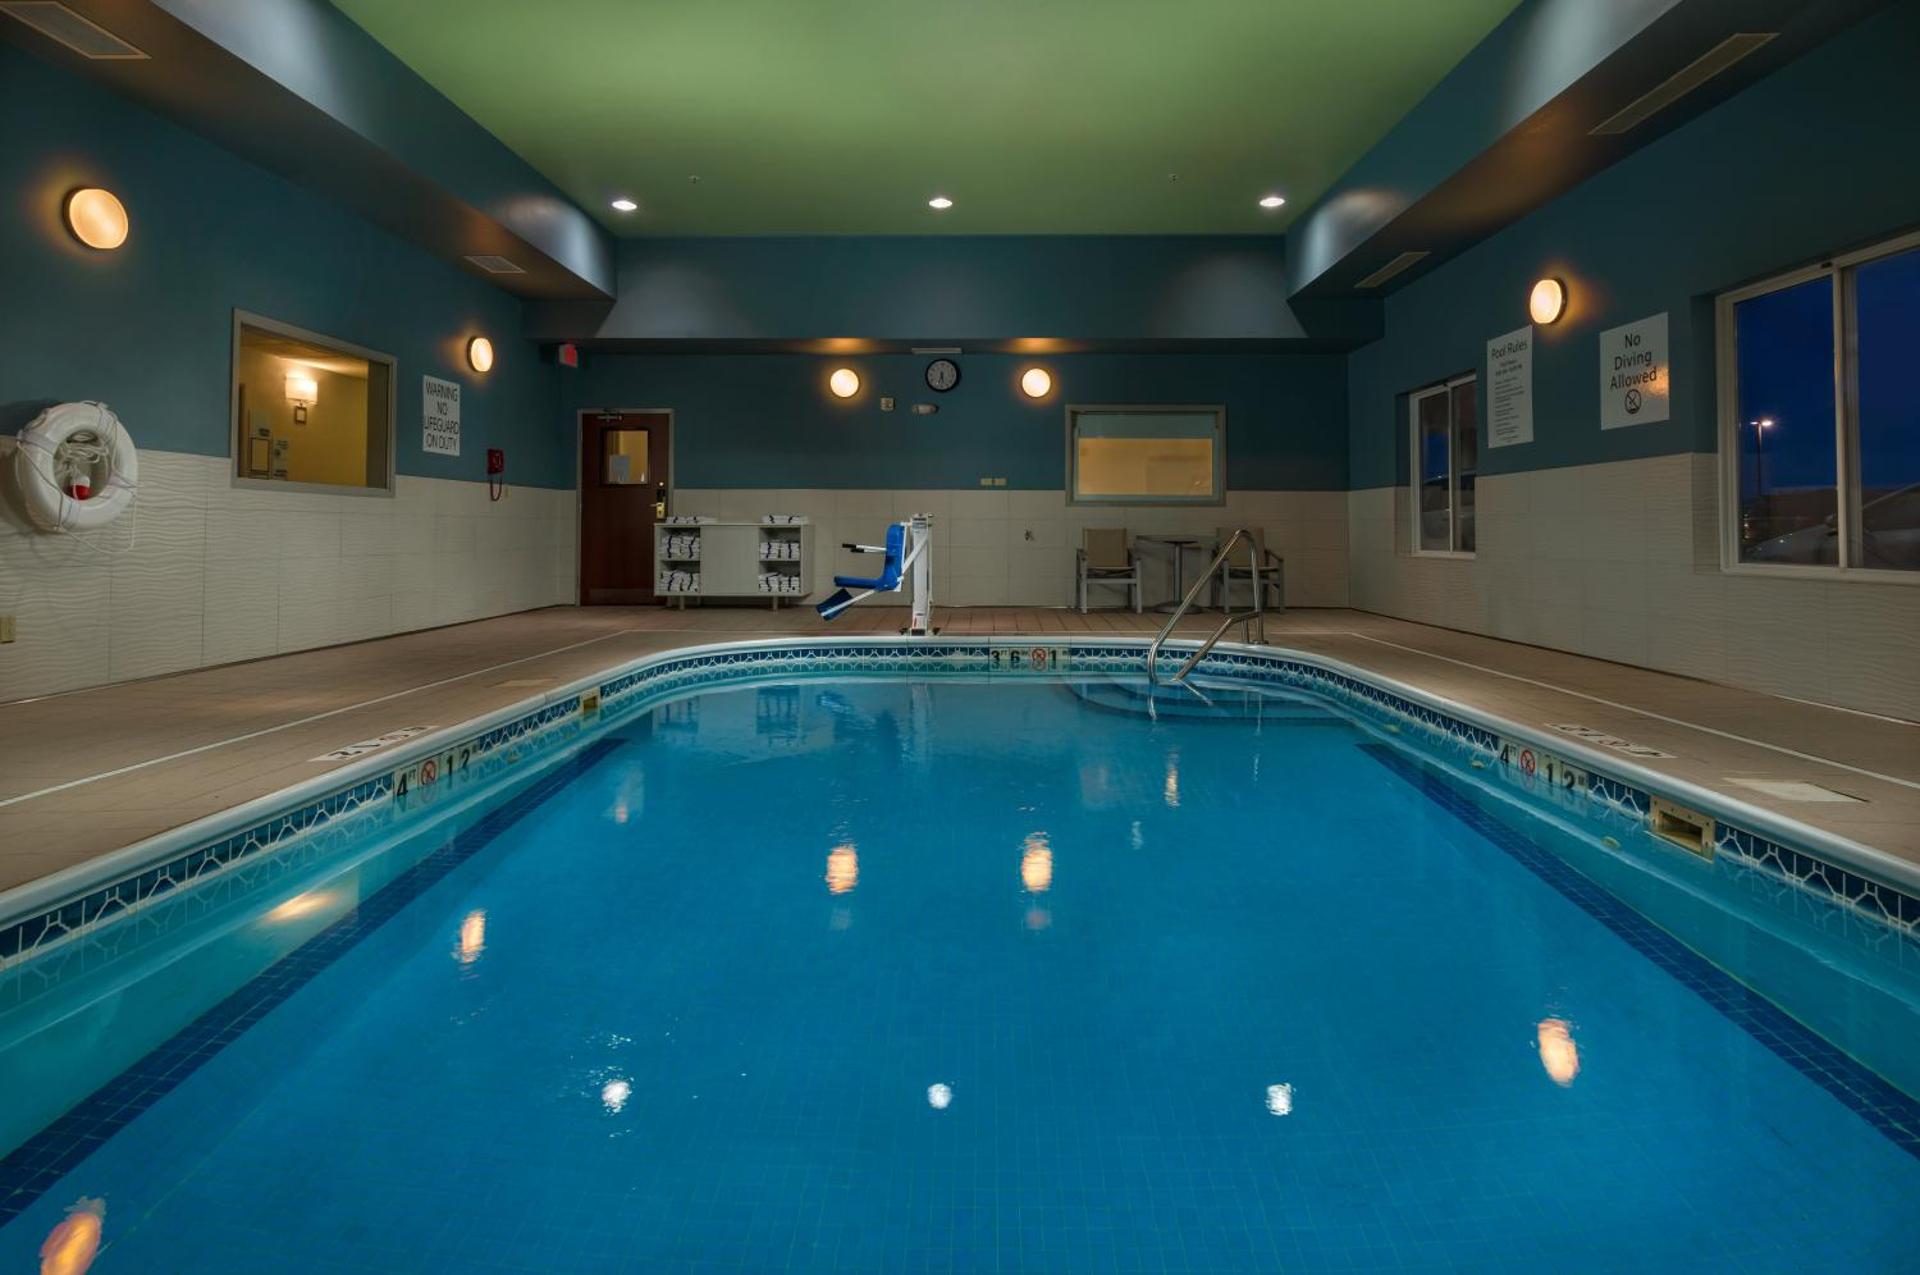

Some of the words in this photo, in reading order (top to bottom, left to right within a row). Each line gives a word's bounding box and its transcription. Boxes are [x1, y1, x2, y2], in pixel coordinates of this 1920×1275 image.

[1491, 345, 1506, 361] Pool
[1507, 339, 1529, 355] Rules
[1624, 332, 1641, 348] No
[1614, 348, 1653, 371] Diving
[1609, 365, 1658, 391] Allowed
[425, 382, 458, 402] WARNING
[437, 401, 448, 415] NO
[424, 414, 459, 436] LIFEGUARD
[427, 432, 438, 449] ON
[438, 435, 458, 451] DUTY
